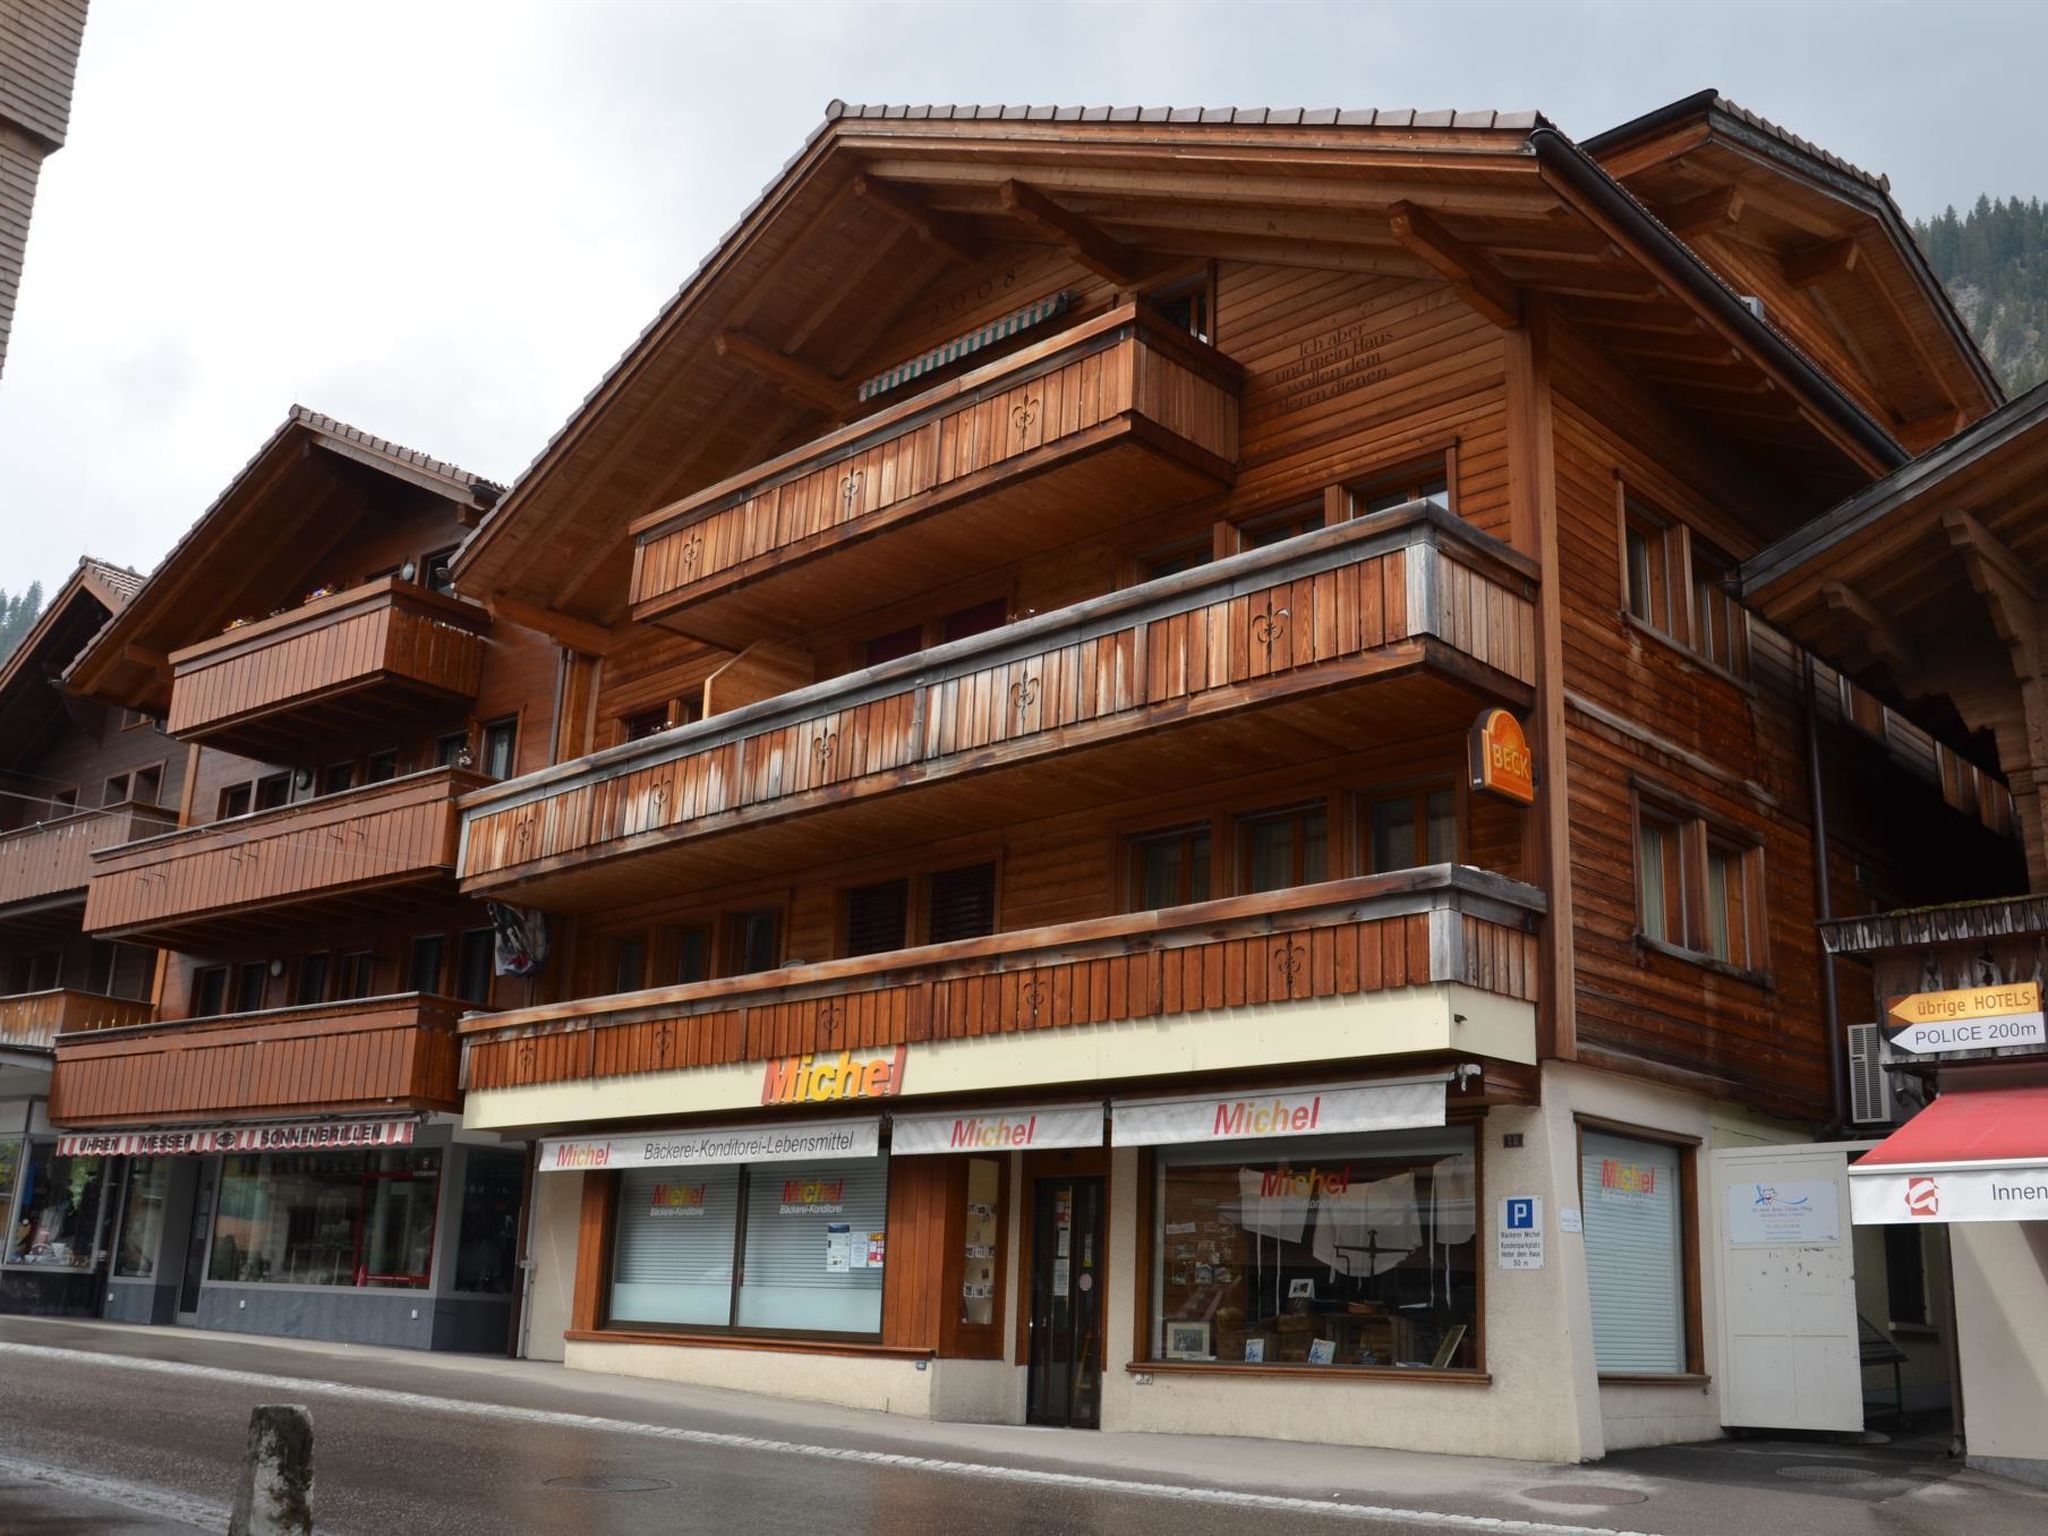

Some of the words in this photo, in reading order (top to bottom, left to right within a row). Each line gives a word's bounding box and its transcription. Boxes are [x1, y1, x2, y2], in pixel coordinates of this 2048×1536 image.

[1275, 357, 1307, 382] und
[1310, 345, 1350, 370] mein
[1353, 329, 1393, 353] Haus
[1298, 335, 1323, 357] Ich
[1327, 322, 1366, 346] aber
[1285, 365, 1341, 393] wollen
[1344, 350, 1381, 372] dem
[1492, 743, 1530, 781] BECK
[1917, 1000, 1966, 1017] übrige
[1974, 991, 2031, 1010] HOTELS
[1915, 1026, 1982, 1045] POLICE
[1988, 1023, 2037, 1040] 200m
[761, 1044, 907, 1105] Michel
[951, 1115, 1036, 1148] Michel
[1213, 1096, 1321, 1135] Michel
[79, 1136, 118, 1151] UHREN
[142, 1133, 193, 1151] MESSER
[260, 1125, 382, 1145] SONNENBRILLEN
[556, 1143, 611, 1167] Michel
[644, 1130, 854, 1162] Bäckerei-Konditorei-Lebensmittel
[653, 1183, 706, 1206] Michel
[783, 1178, 846, 1204] Michel
[1260, 1164, 1351, 1198] Michel
[1991, 1182, 2048, 1201] Innen
[1514, 1203, 1527, 1226] P
